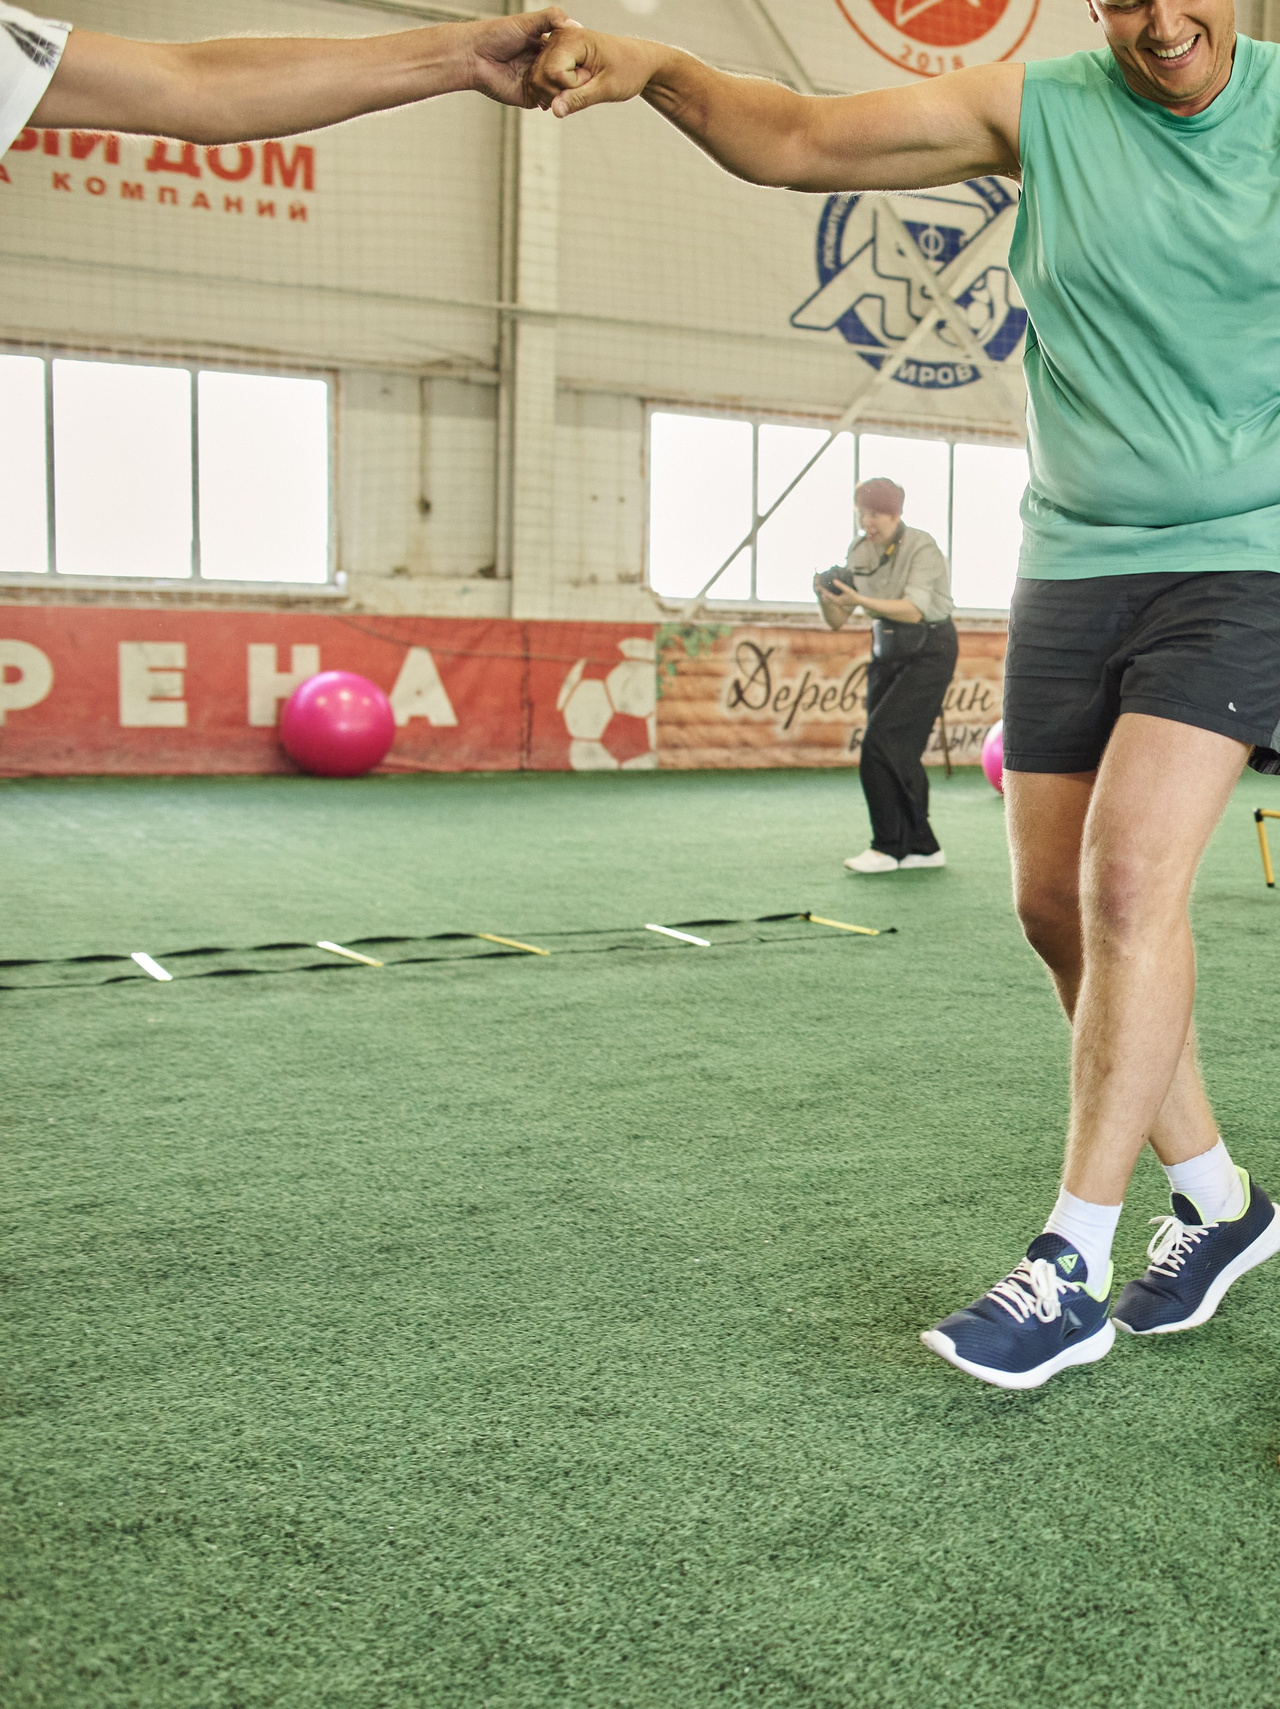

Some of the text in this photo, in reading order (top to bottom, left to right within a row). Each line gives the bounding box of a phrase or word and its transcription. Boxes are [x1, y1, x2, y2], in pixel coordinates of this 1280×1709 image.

[145, 140, 315, 192] ДОМ
[52, 171, 308, 222] КОМПАНИЙ
[897, 362, 973, 386] ИРОВ
[0, 638, 458, 727] РЕНА
